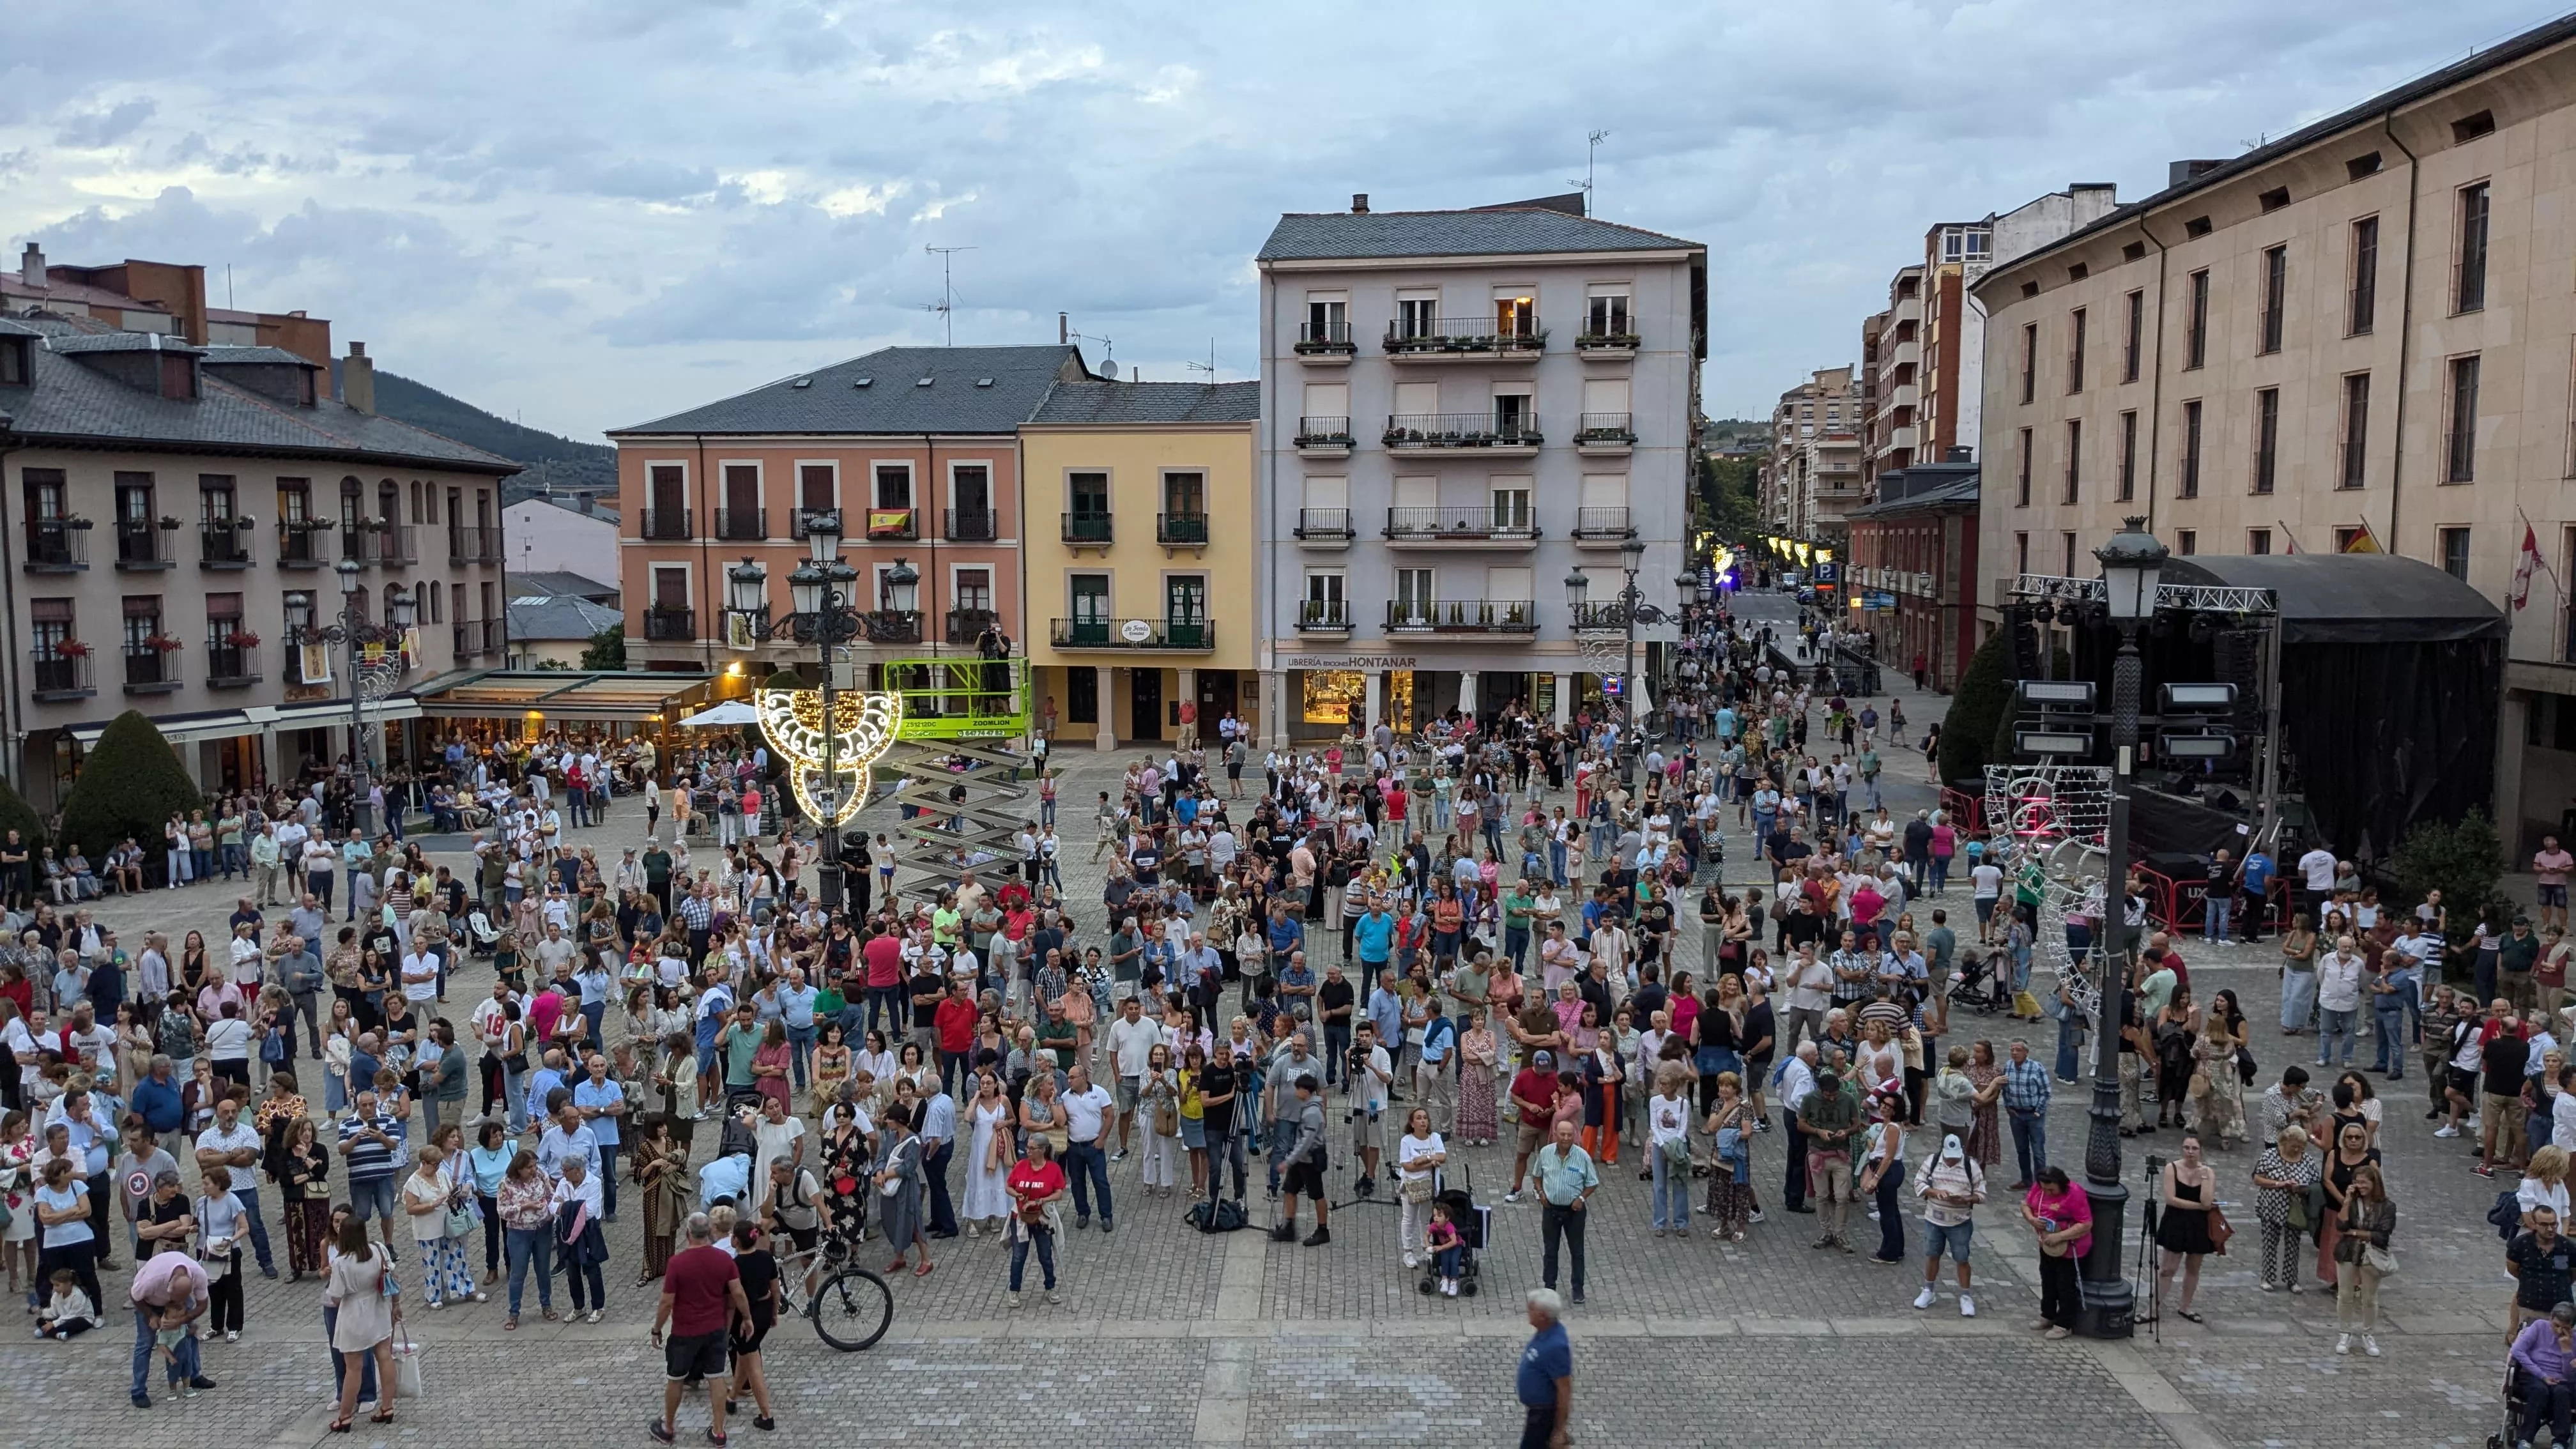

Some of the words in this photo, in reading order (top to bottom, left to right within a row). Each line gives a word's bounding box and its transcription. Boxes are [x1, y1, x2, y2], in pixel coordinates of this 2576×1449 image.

[1288, 656, 1321, 666] LIBRERÍA
[1349, 657, 1416, 668] HONTANAR
[486, 1013, 505, 1036] 18
